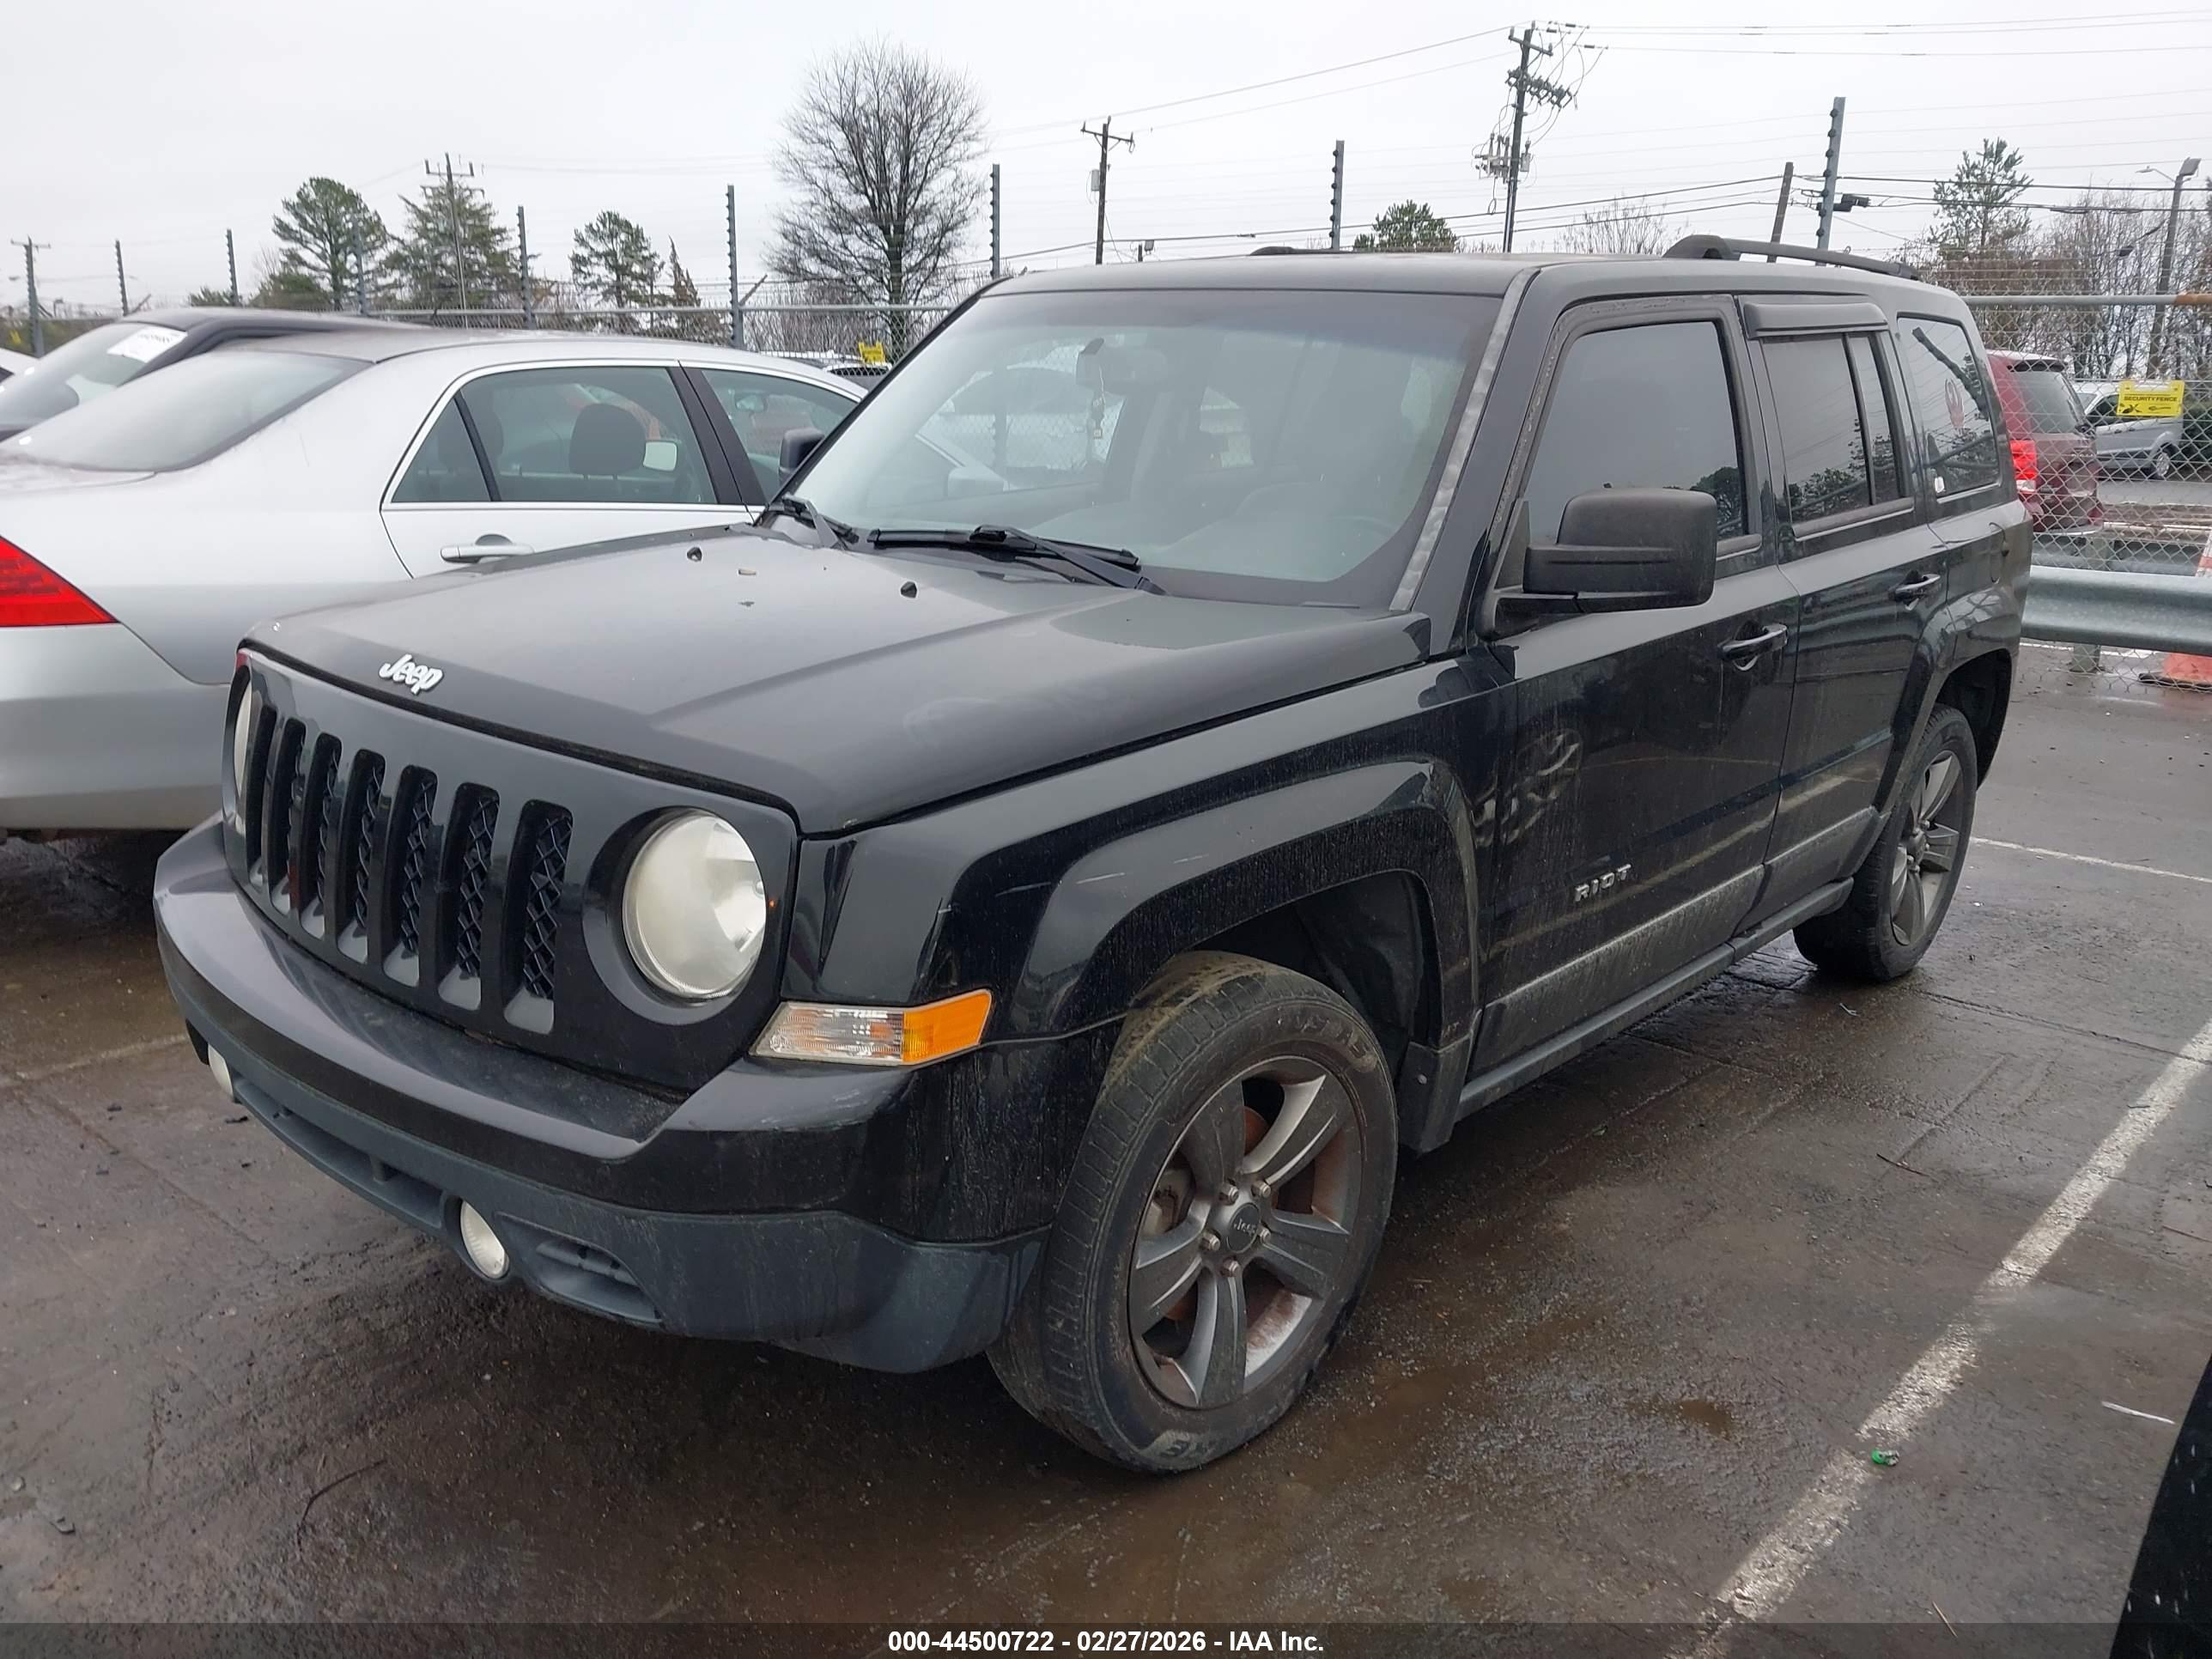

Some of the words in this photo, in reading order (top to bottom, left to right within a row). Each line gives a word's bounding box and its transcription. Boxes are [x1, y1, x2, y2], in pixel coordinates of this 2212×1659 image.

[379, 653, 443, 695] Jeep
[1574, 863, 1632, 902] RIOT
[1233, 1218, 1256, 1237] Jeep
